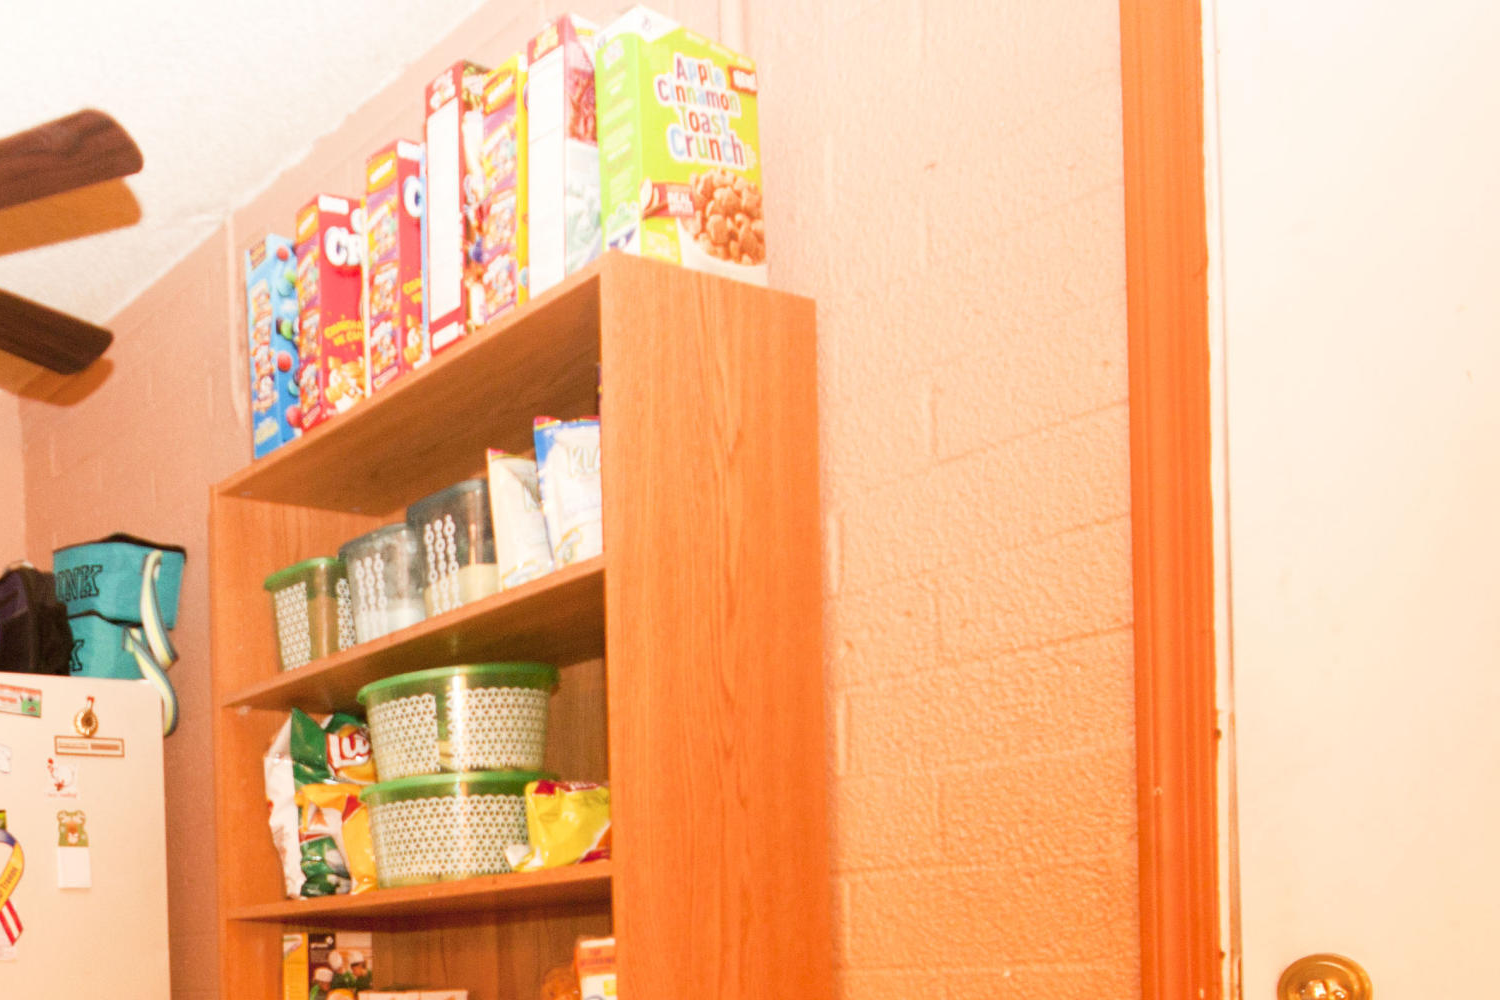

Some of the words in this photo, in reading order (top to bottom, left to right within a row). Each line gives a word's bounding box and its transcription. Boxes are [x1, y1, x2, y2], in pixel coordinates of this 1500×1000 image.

[674, 54, 727, 88] Apple
[656, 77, 741, 113] Cinnamon
[678, 105, 730, 137] Toast
[669, 127, 745, 167] Crunch
